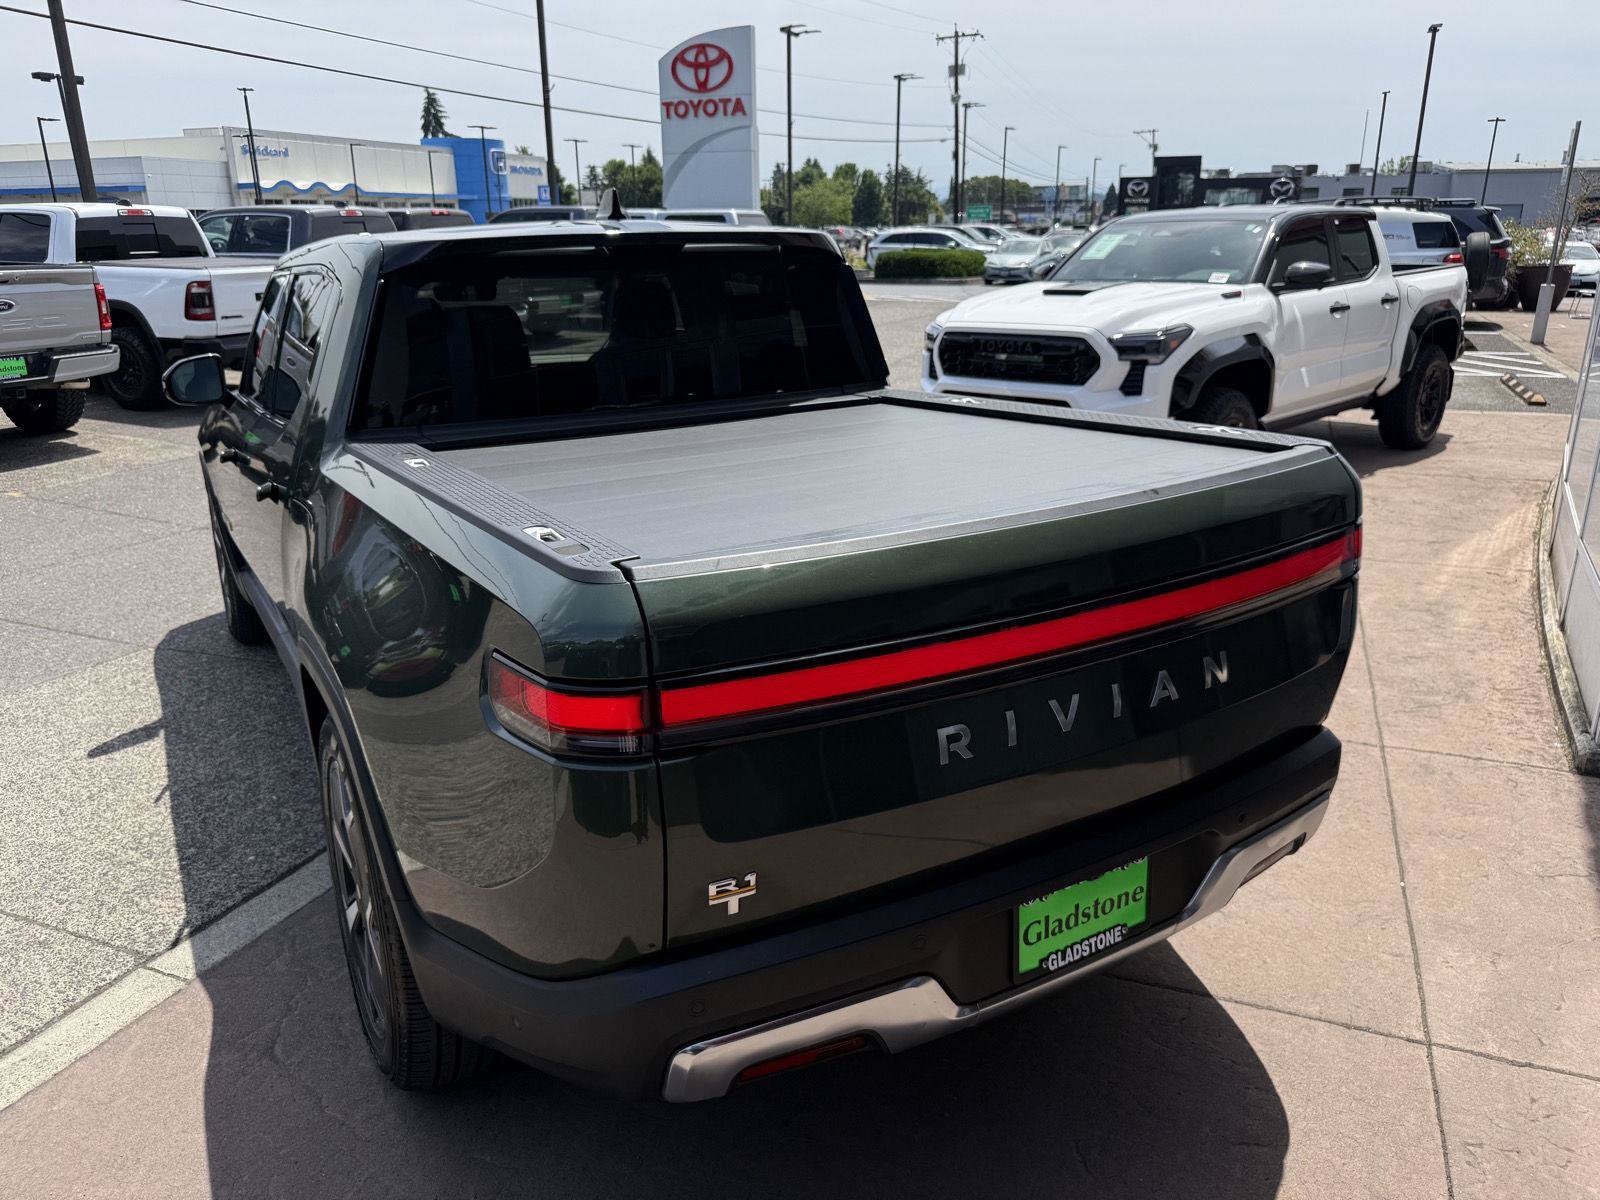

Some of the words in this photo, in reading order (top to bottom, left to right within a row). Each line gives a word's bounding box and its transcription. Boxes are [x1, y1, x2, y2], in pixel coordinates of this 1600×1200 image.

[661, 97, 747, 119] TOYOTA
[979, 340, 1033, 353] TOYOTA
[936, 651, 1229, 765] RIVIAN
[1022, 885, 1145, 946] Gladstone
[1048, 926, 1123, 971] GLADSTONE
